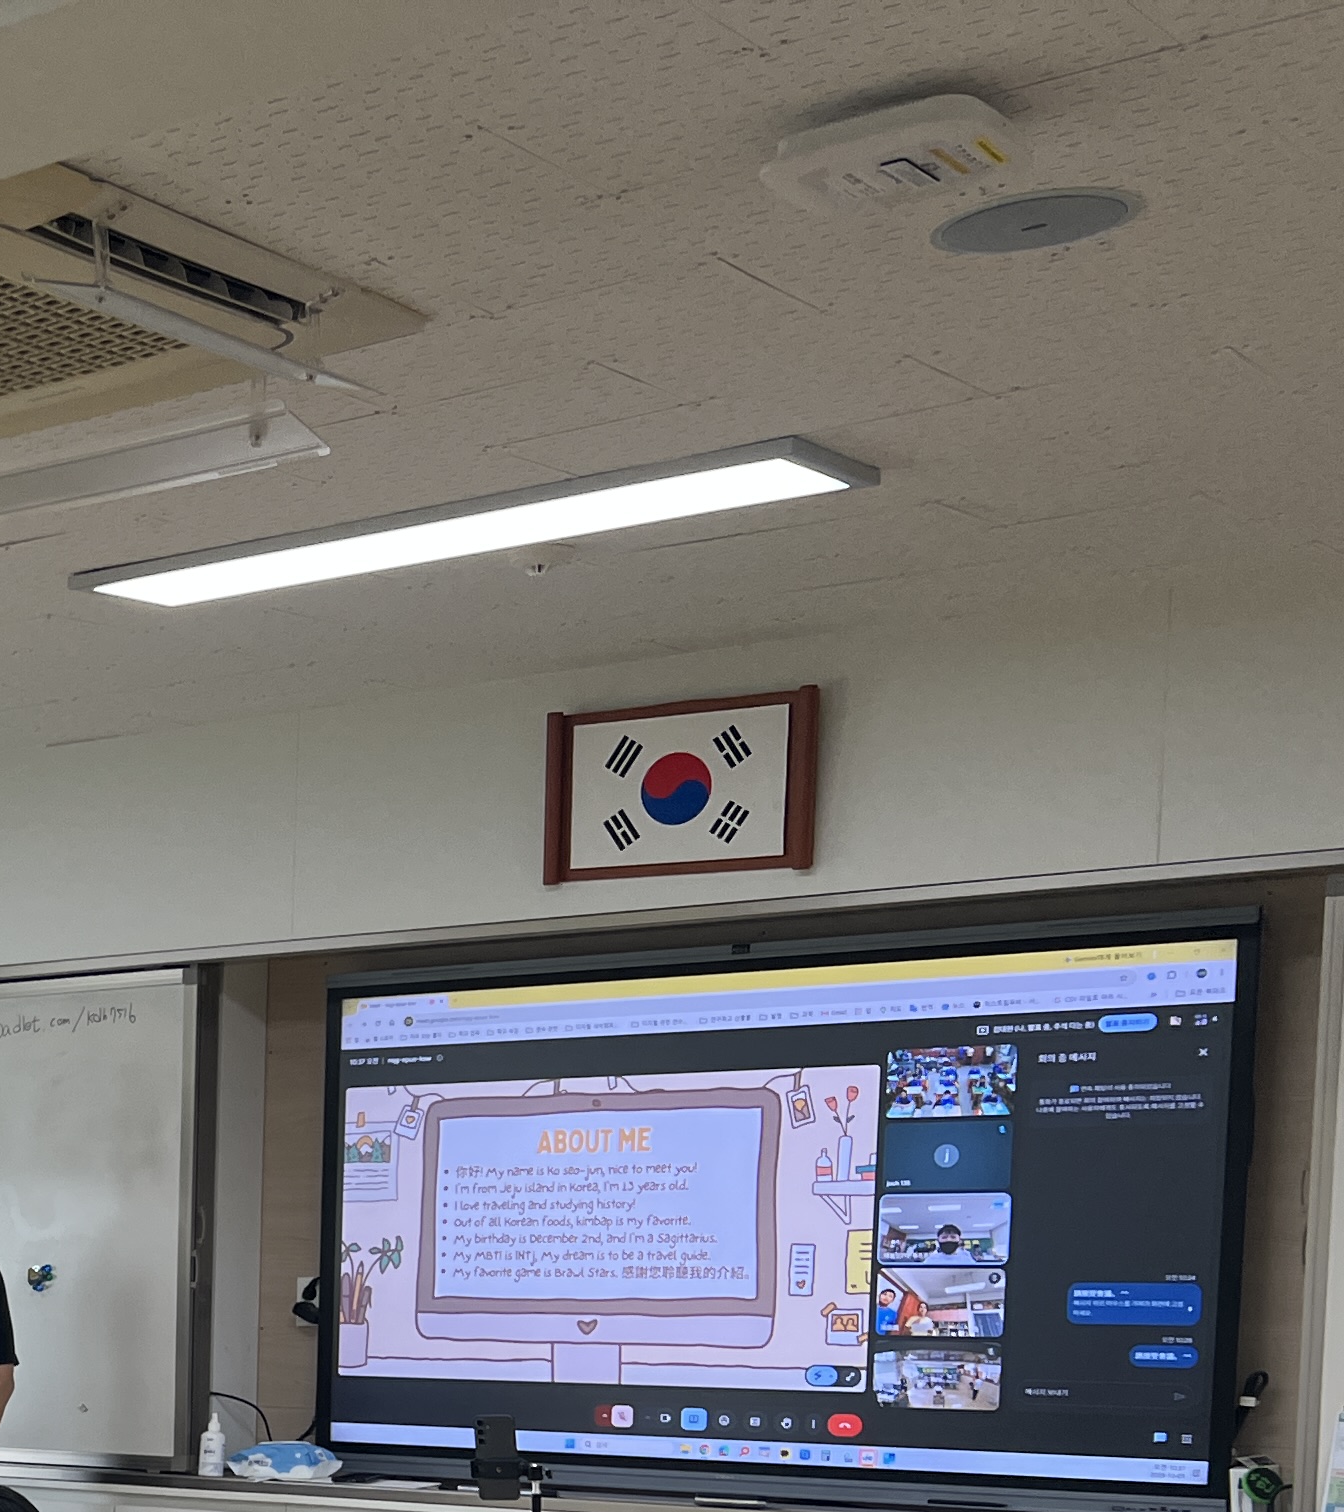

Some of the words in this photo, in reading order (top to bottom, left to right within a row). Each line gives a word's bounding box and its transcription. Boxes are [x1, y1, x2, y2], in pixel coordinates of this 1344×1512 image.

[537, 1128, 613, 1154] ABOUT
[618, 1127, 652, 1152] ME
[486, 1167, 504, 1180] My
[507, 1166, 533, 1176] name
[536, 1165, 544, 1175] is
[608, 1163, 629, 1175] nice
[632, 1163, 643, 1173] to
[646, 1163, 671, 1173] meet
[674, 1161, 698, 1176] you!
[455, 1183, 469, 1194] I'm
[472, 1182, 497, 1194] from
[525, 1181, 554, 1193] island
[557, 1182, 567, 1192] in
[569, 1182, 601, 1195] Korea,
[603, 1180, 619, 1191] I'm
[637, 1181, 666, 1195] years
[668, 1178, 689, 1191] old.
[460, 1200, 480, 1211] love
[483, 1200, 525, 1215] traveling
[528, 1199, 547, 1210] and
[550, 1198, 593, 1215] studying
[596, 1197, 636, 1212] history!
[474, 1216, 486, 1227] of
[489, 1216, 501, 1227] all
[504, 1216, 539, 1227] Korean
[542, 1215, 573, 1229] foods,
[576, 1215, 613, 1231] kimbap
[616, 1216, 624, 1226] is
[626, 1217, 643, 1229] my
[647, 1214, 692, 1226] favorite.
[453, 1234, 472, 1247] My
[474, 1233, 516, 1247] birthday
[519, 1233, 527, 1243] is
[529, 1233, 578, 1244] December
[581, 1232, 603, 1246] 2nd,
[606, 1232, 627, 1243] and
[629, 1232, 645, 1243] I'm
[647, 1234, 654, 1243] a
[656, 1232, 718, 1248] Sagittarius.
[453, 1251, 472, 1263] My
[474, 1250, 503, 1261] MBTI
[505, 1250, 513, 1260] is
[540, 1251, 560, 1264] My
[562, 1249, 594, 1260] dream
[596, 1250, 605, 1260] is
[608, 1250, 619, 1260] to
[621, 1250, 634, 1260] be
[637, 1251, 644, 1260] a
[647, 1250, 677, 1261] travel
[680, 1249, 711, 1265] guide.
[452, 1267, 471, 1280] My
[474, 1266, 512, 1278] favorite
[514, 1267, 541, 1283] game
[544, 1267, 552, 1277] is
[554, 1266, 585, 1278] Brawl
[587, 1266, 619, 1278] Stars.
